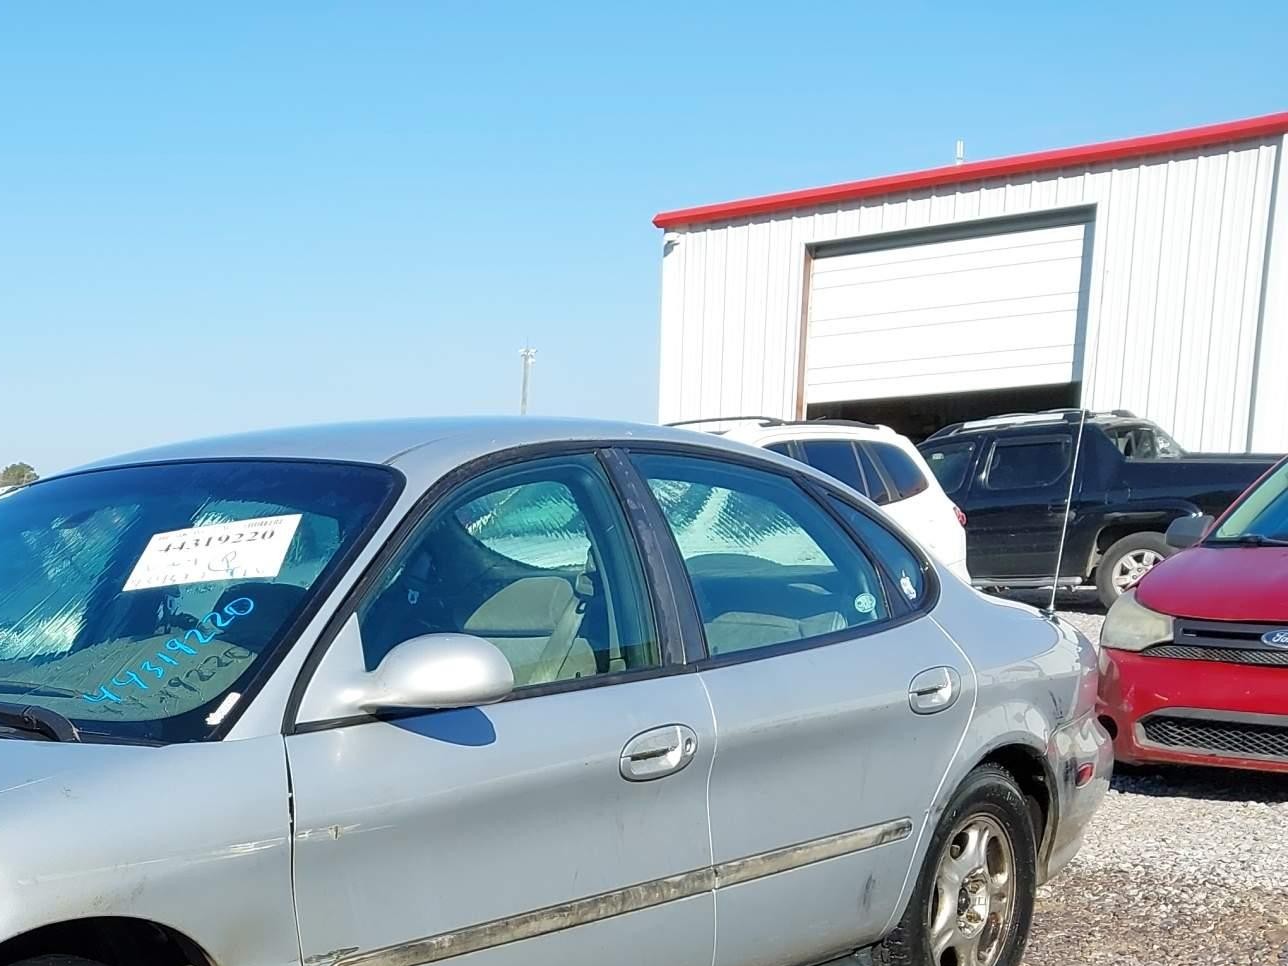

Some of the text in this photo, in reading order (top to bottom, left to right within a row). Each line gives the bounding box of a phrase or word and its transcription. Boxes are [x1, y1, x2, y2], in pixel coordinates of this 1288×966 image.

[158, 529, 276, 553] 44319220
[1271, 631, 1288, 643] Fo
[82, 597, 255, 704] 44319220
